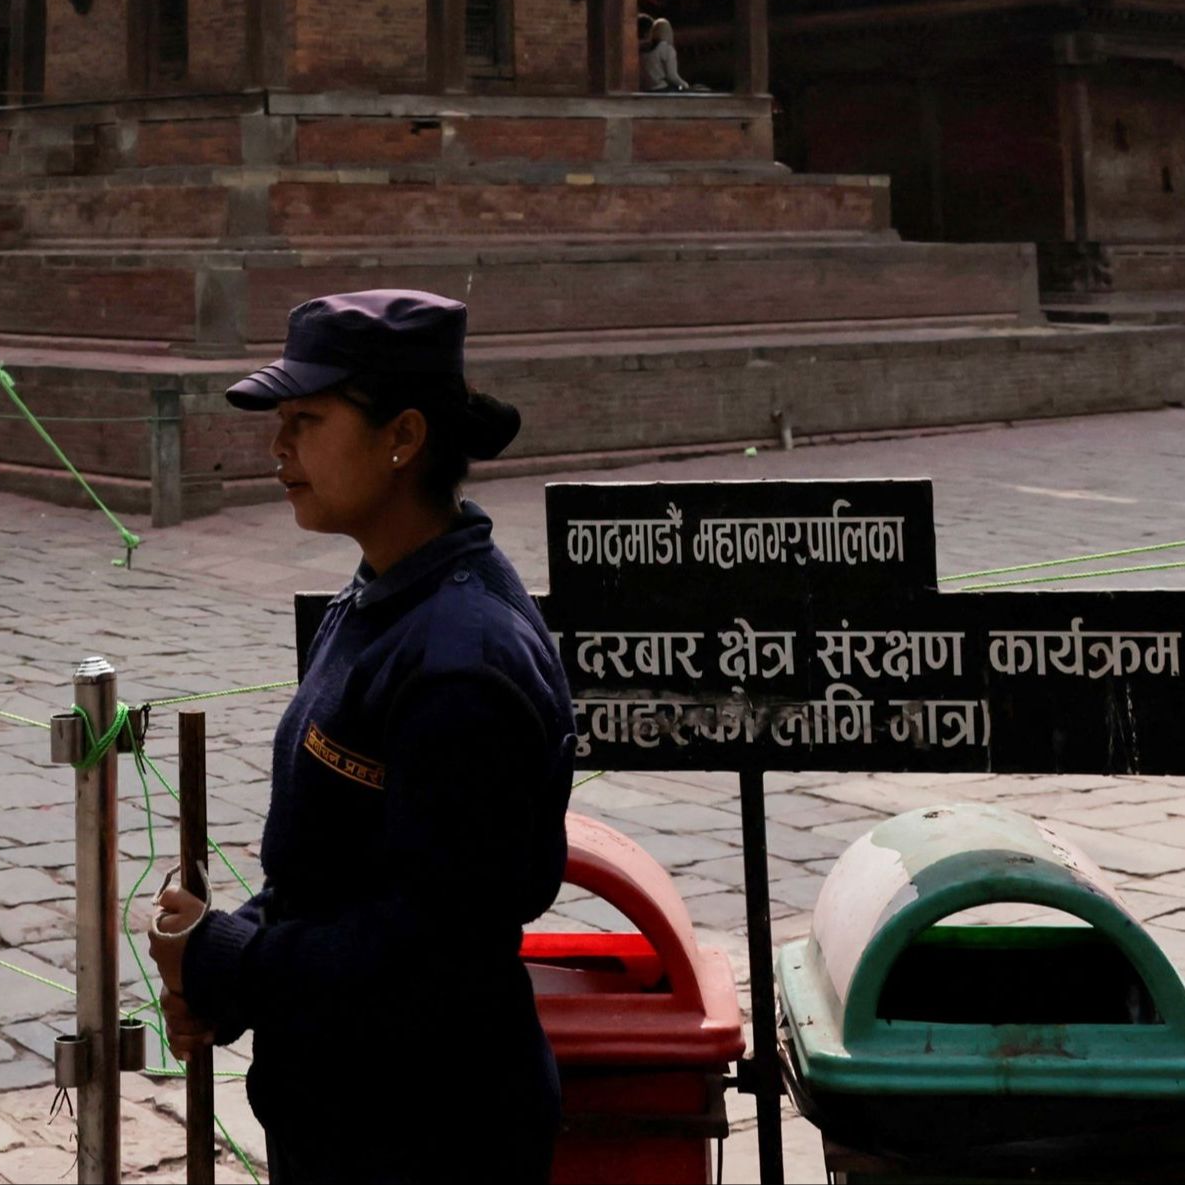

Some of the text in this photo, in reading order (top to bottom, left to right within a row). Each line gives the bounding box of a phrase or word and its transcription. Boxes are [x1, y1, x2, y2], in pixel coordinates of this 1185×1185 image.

[693, 498, 905, 569] महानगरपालिका
[575, 631, 705, 679] दरबार
[718, 617, 796, 682] क्षेत्र
[816, 619, 965, 682] संरक्षण
[988, 617, 1182, 680] कार्यक्रम
[768, 682, 874, 747] लागि
